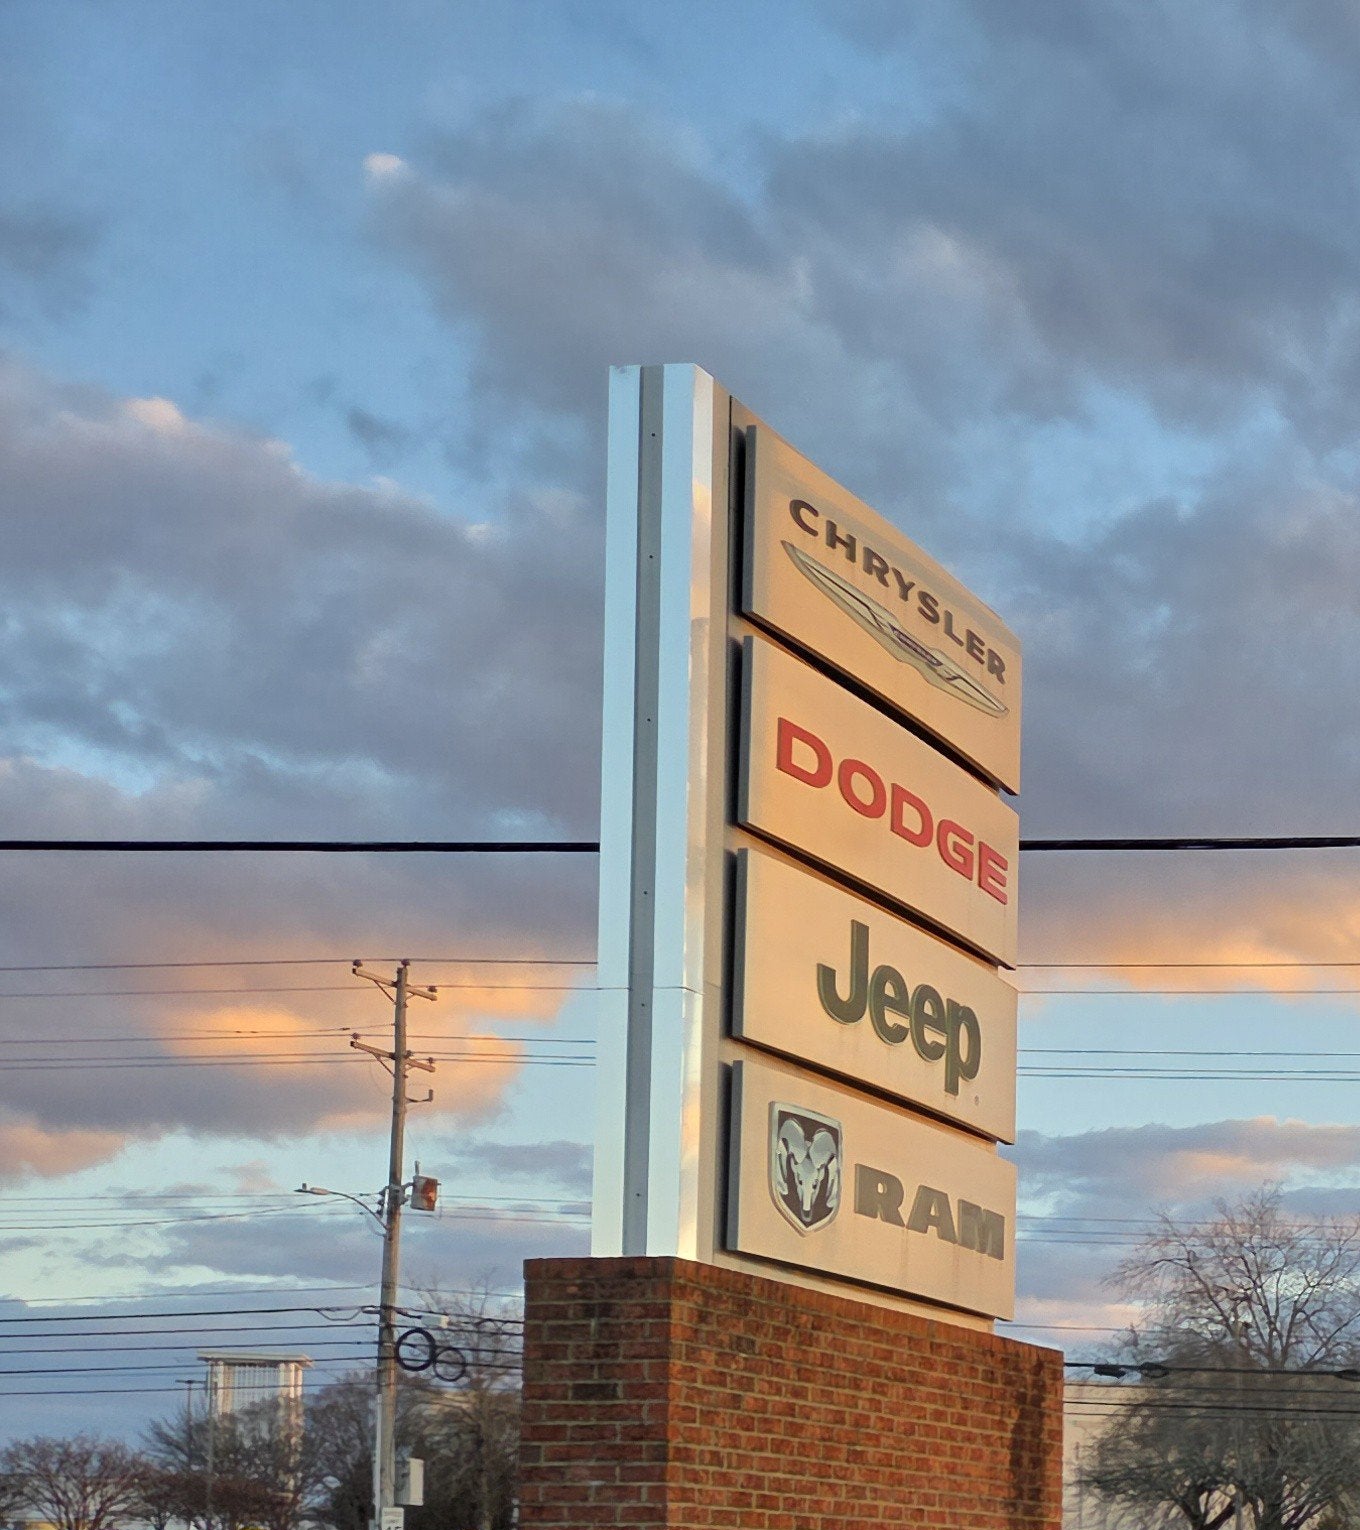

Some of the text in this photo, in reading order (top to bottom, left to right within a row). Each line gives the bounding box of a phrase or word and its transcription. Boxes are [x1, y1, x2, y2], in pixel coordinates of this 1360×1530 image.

[789, 499, 1006, 686] CHRYSLER
[776, 716, 1009, 906] DODGE
[816, 918, 982, 1096] Jeep
[854, 1162, 1005, 1261] RAM
